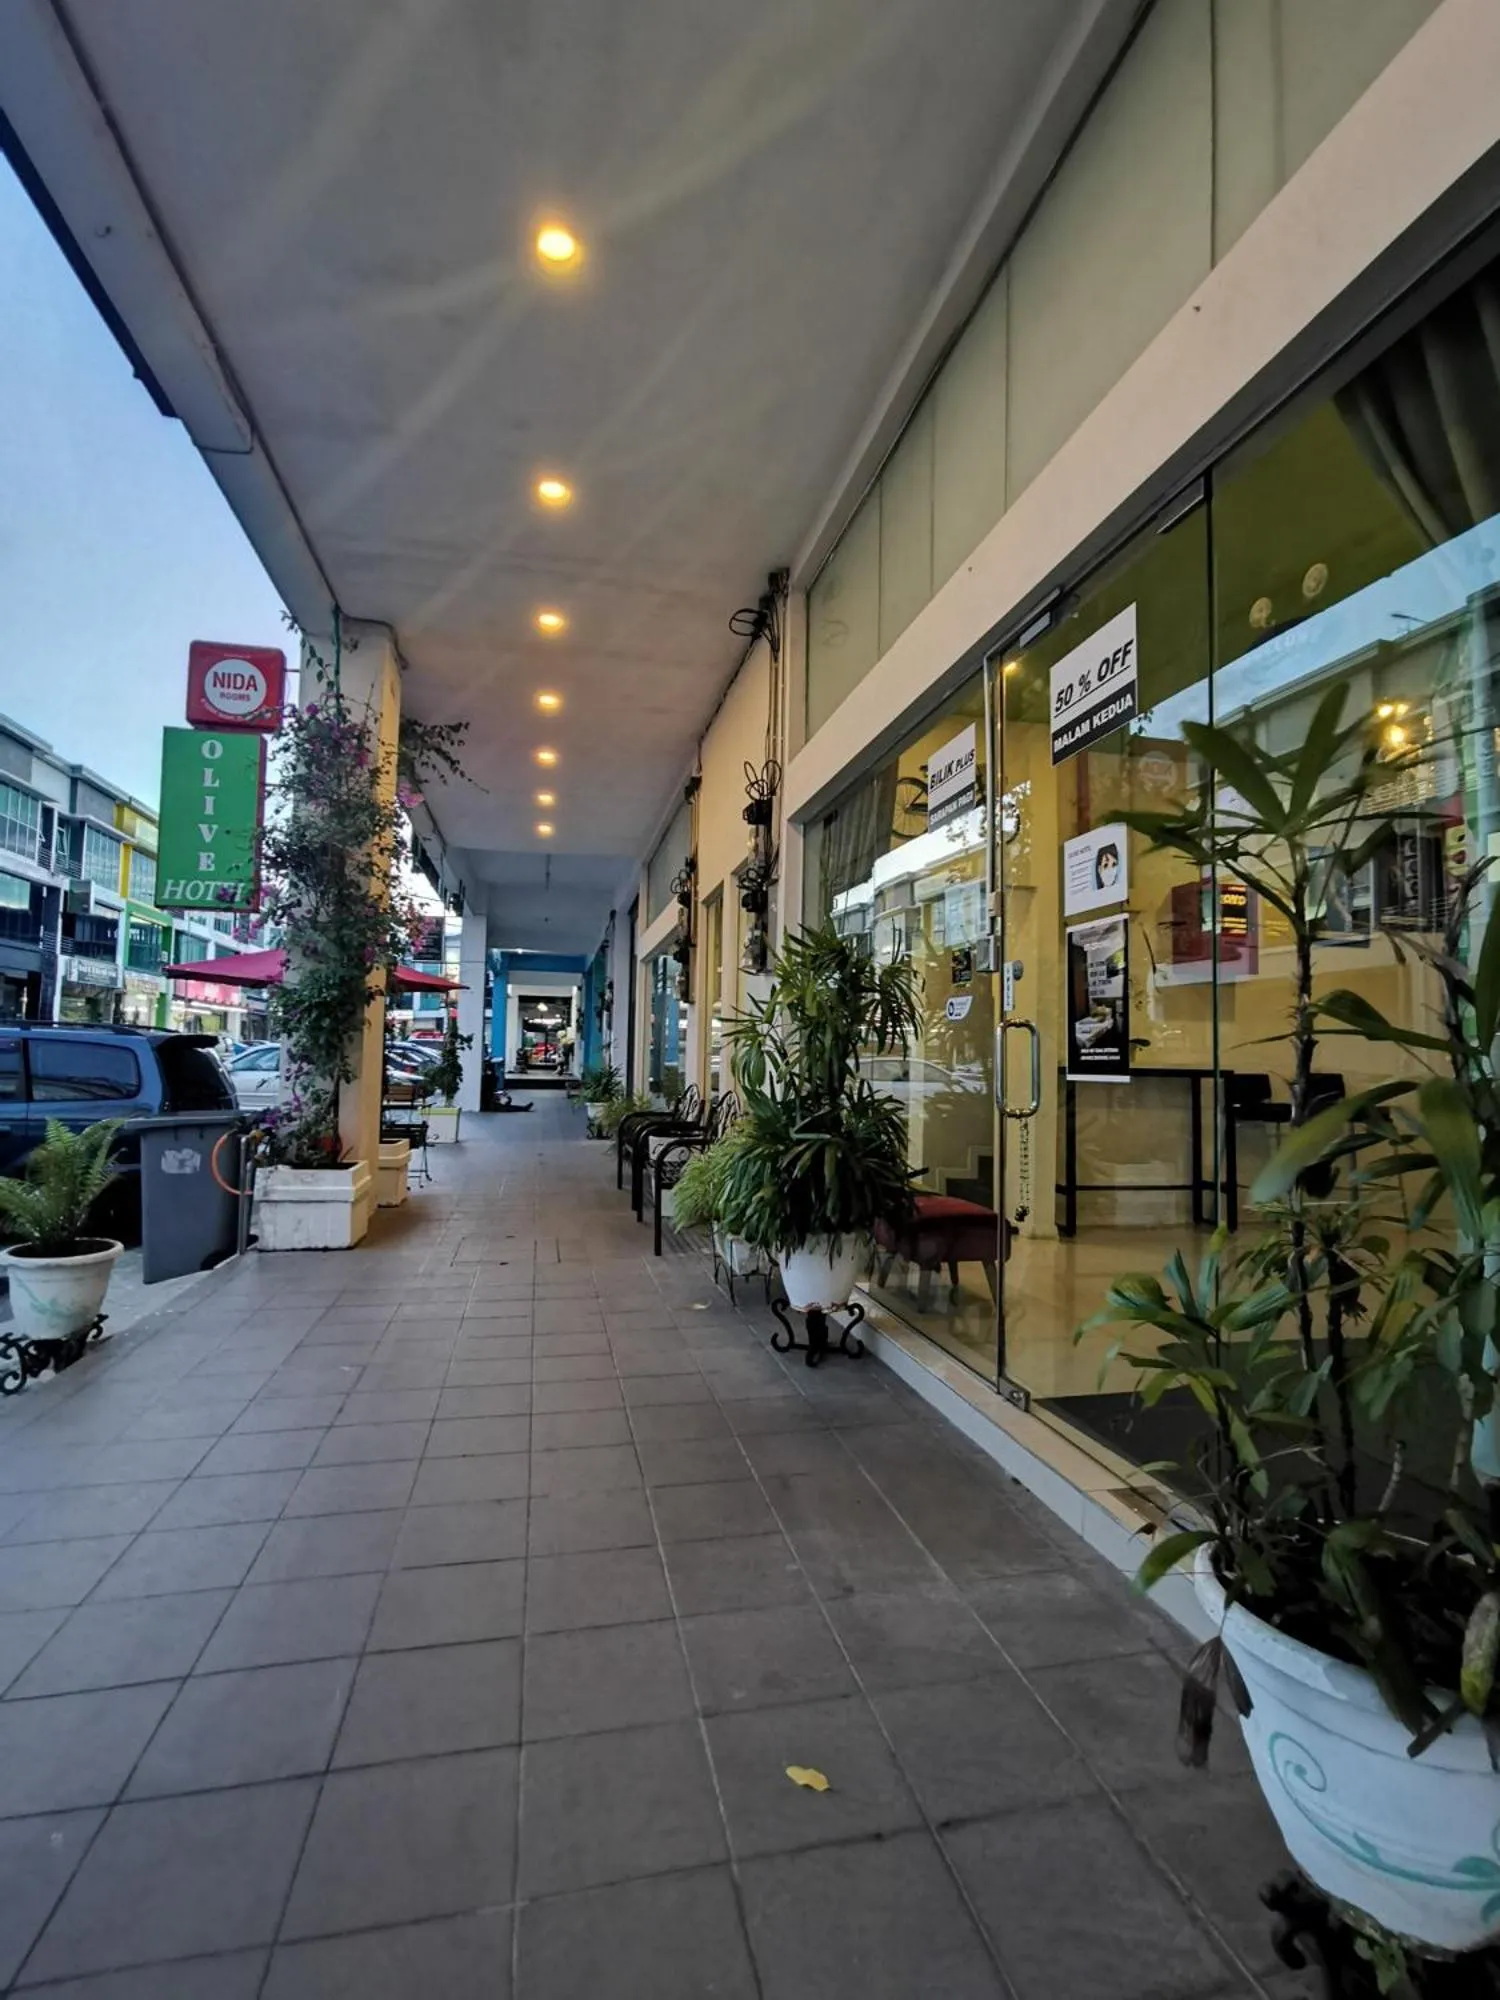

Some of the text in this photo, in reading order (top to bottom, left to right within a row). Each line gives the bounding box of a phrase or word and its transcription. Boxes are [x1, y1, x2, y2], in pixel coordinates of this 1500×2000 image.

[212, 671, 258, 692] NIDA
[219, 691, 252, 702] ROOMS
[1054, 638, 1134, 713] 50 % OFF
[1053, 693, 1134, 753] MALAM KEDUA
[930, 748, 975, 790] BILIK PLUS
[198, 739, 223, 872] OLIVE
